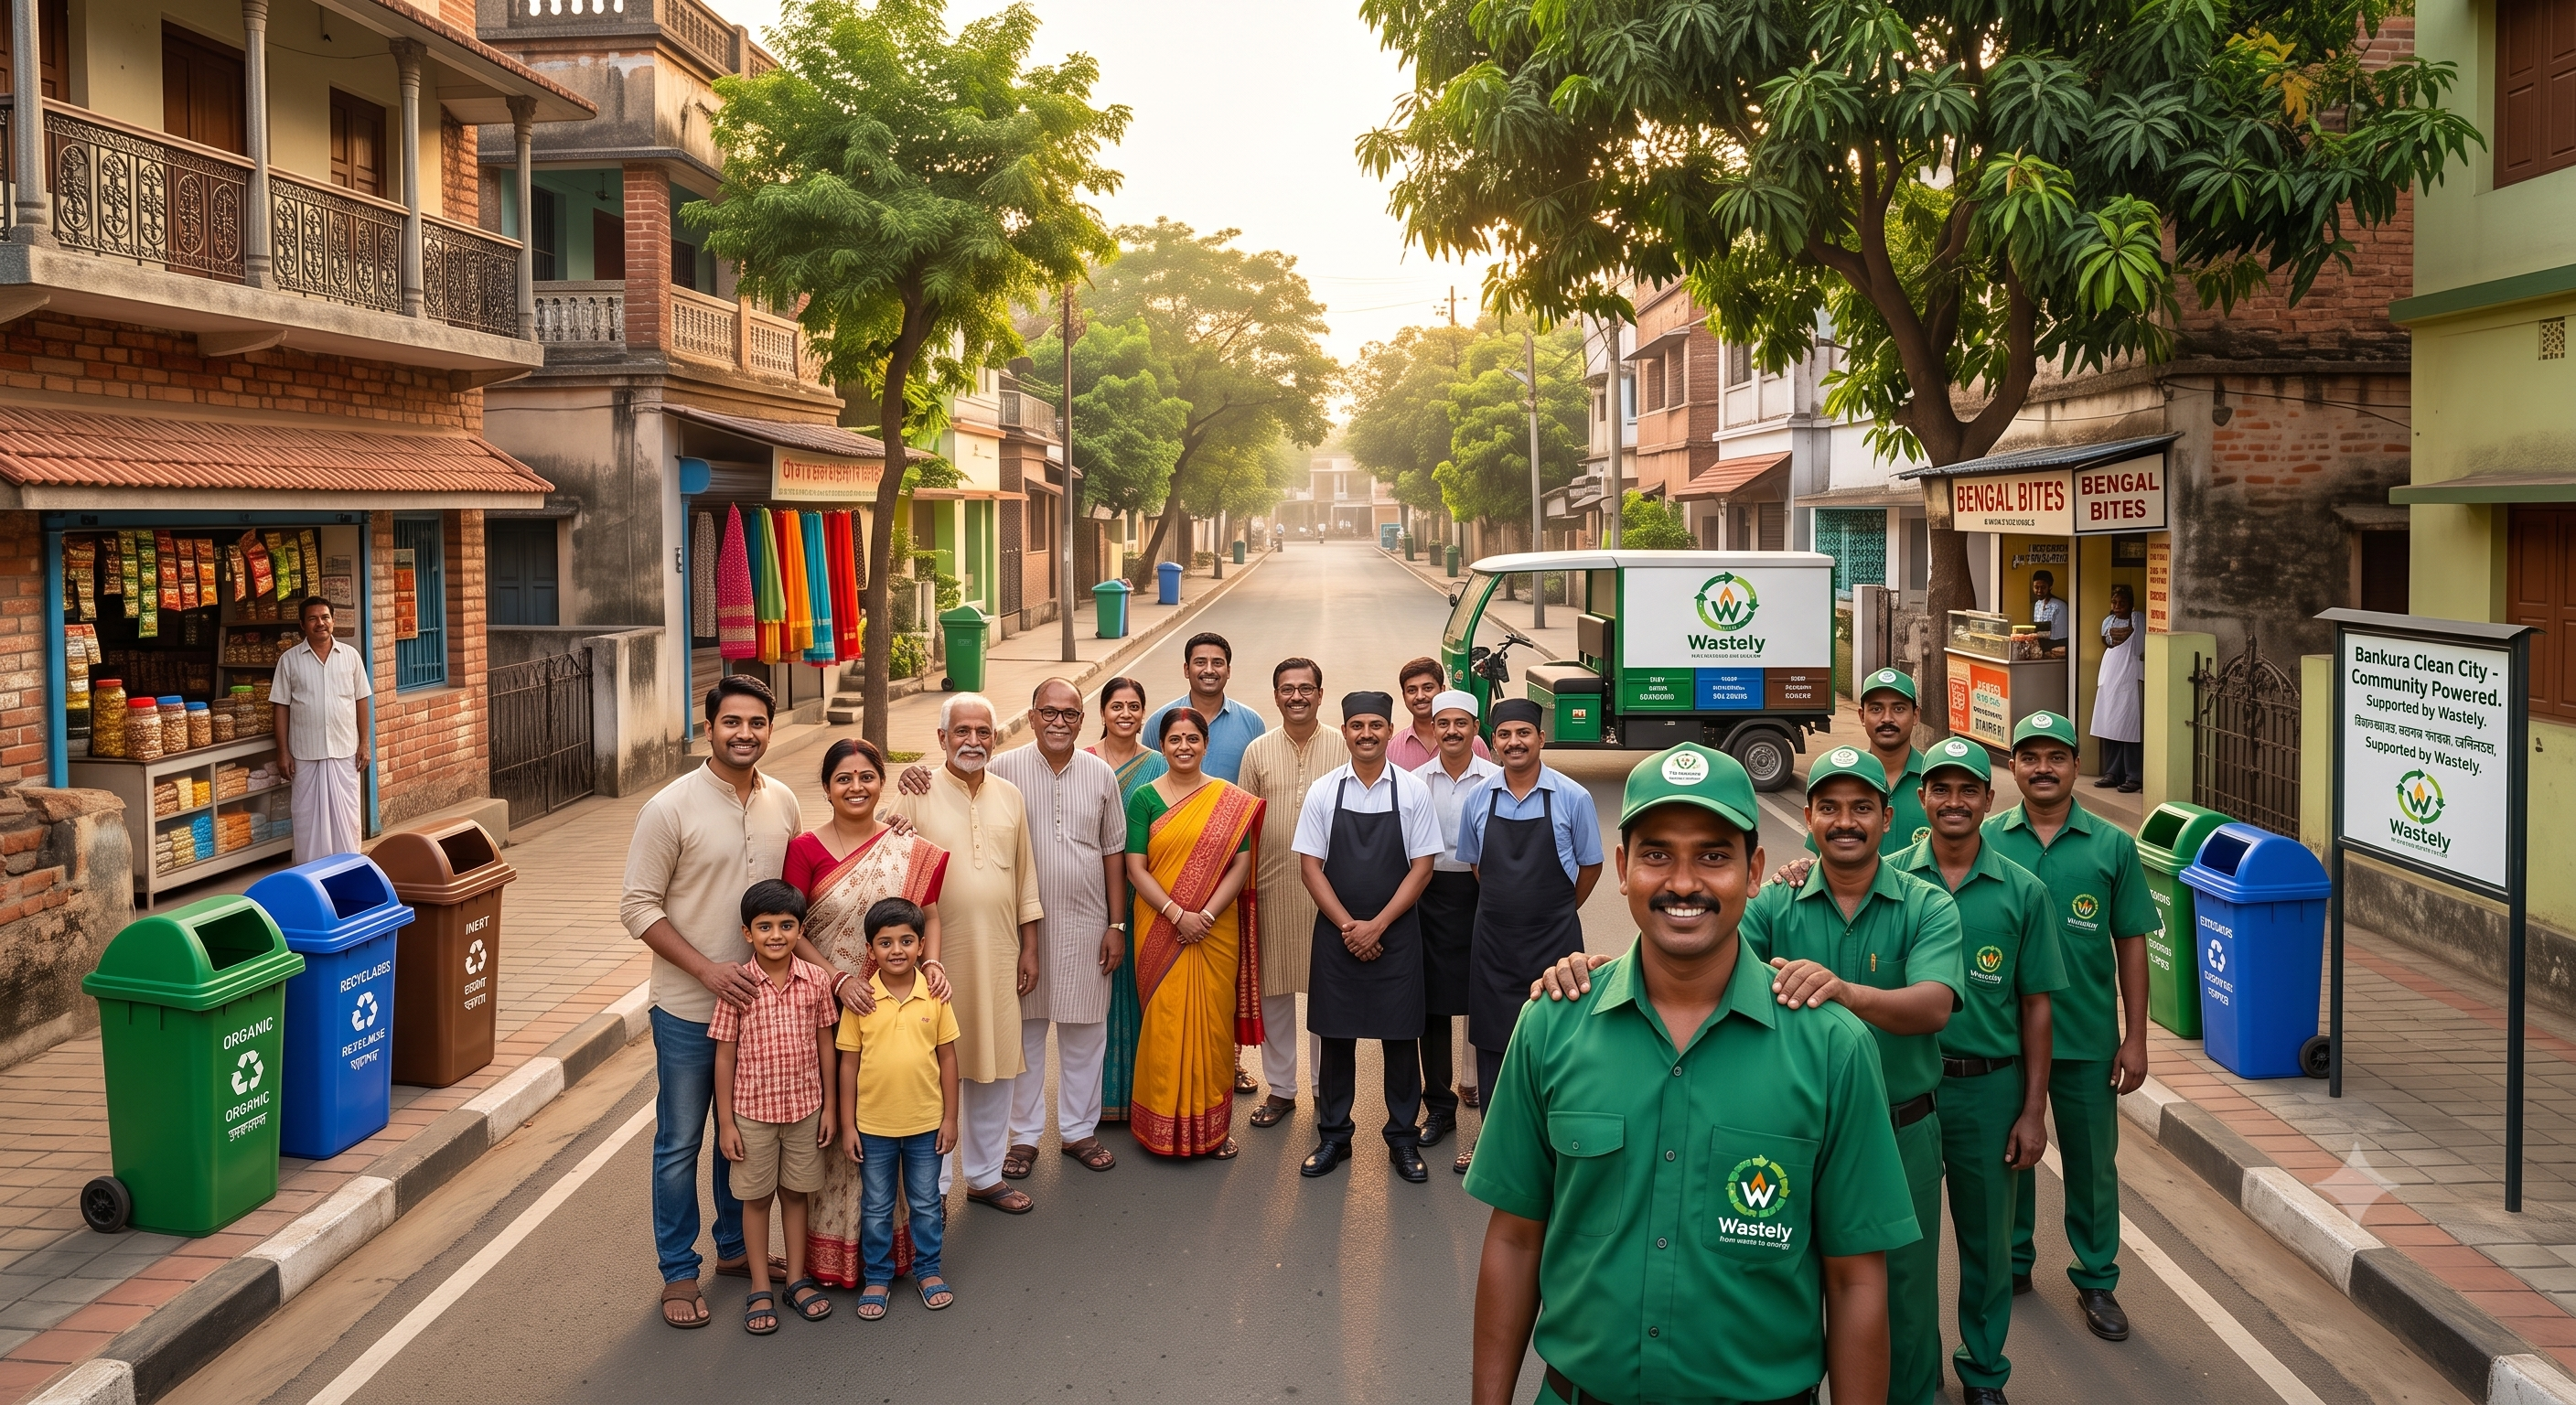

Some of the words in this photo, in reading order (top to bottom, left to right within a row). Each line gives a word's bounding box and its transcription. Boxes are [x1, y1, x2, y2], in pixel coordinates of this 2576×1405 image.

[1957, 482, 2013, 512] BENGAL
[2017, 480, 2065, 511] BITES
[2081, 472, 2160, 495] BENGAL
[2090, 499, 2146, 521] BITES
[1687, 634, 1766, 653] Wastely
[2355, 646, 2410, 669] Bankura
[2414, 654, 2453, 675] Clean
[2458, 660, 2488, 684] City
[2352, 669, 2428, 700] Community
[2431, 681, 2502, 707] Powered.
[2367, 694, 2419, 715] Supported
[2421, 702, 2435, 721] by
[2438, 705, 2487, 730] Wastely.
[2366, 736, 2416, 758] Supported
[2419, 747, 2431, 765] by
[2434, 750, 2482, 777] Wastely.
[2389, 818, 2452, 853] Wastely
[466, 915, 490, 935] INERT
[223, 1016, 273, 1050] ORGANIC
[1718, 1217, 1793, 1243] Wastely
